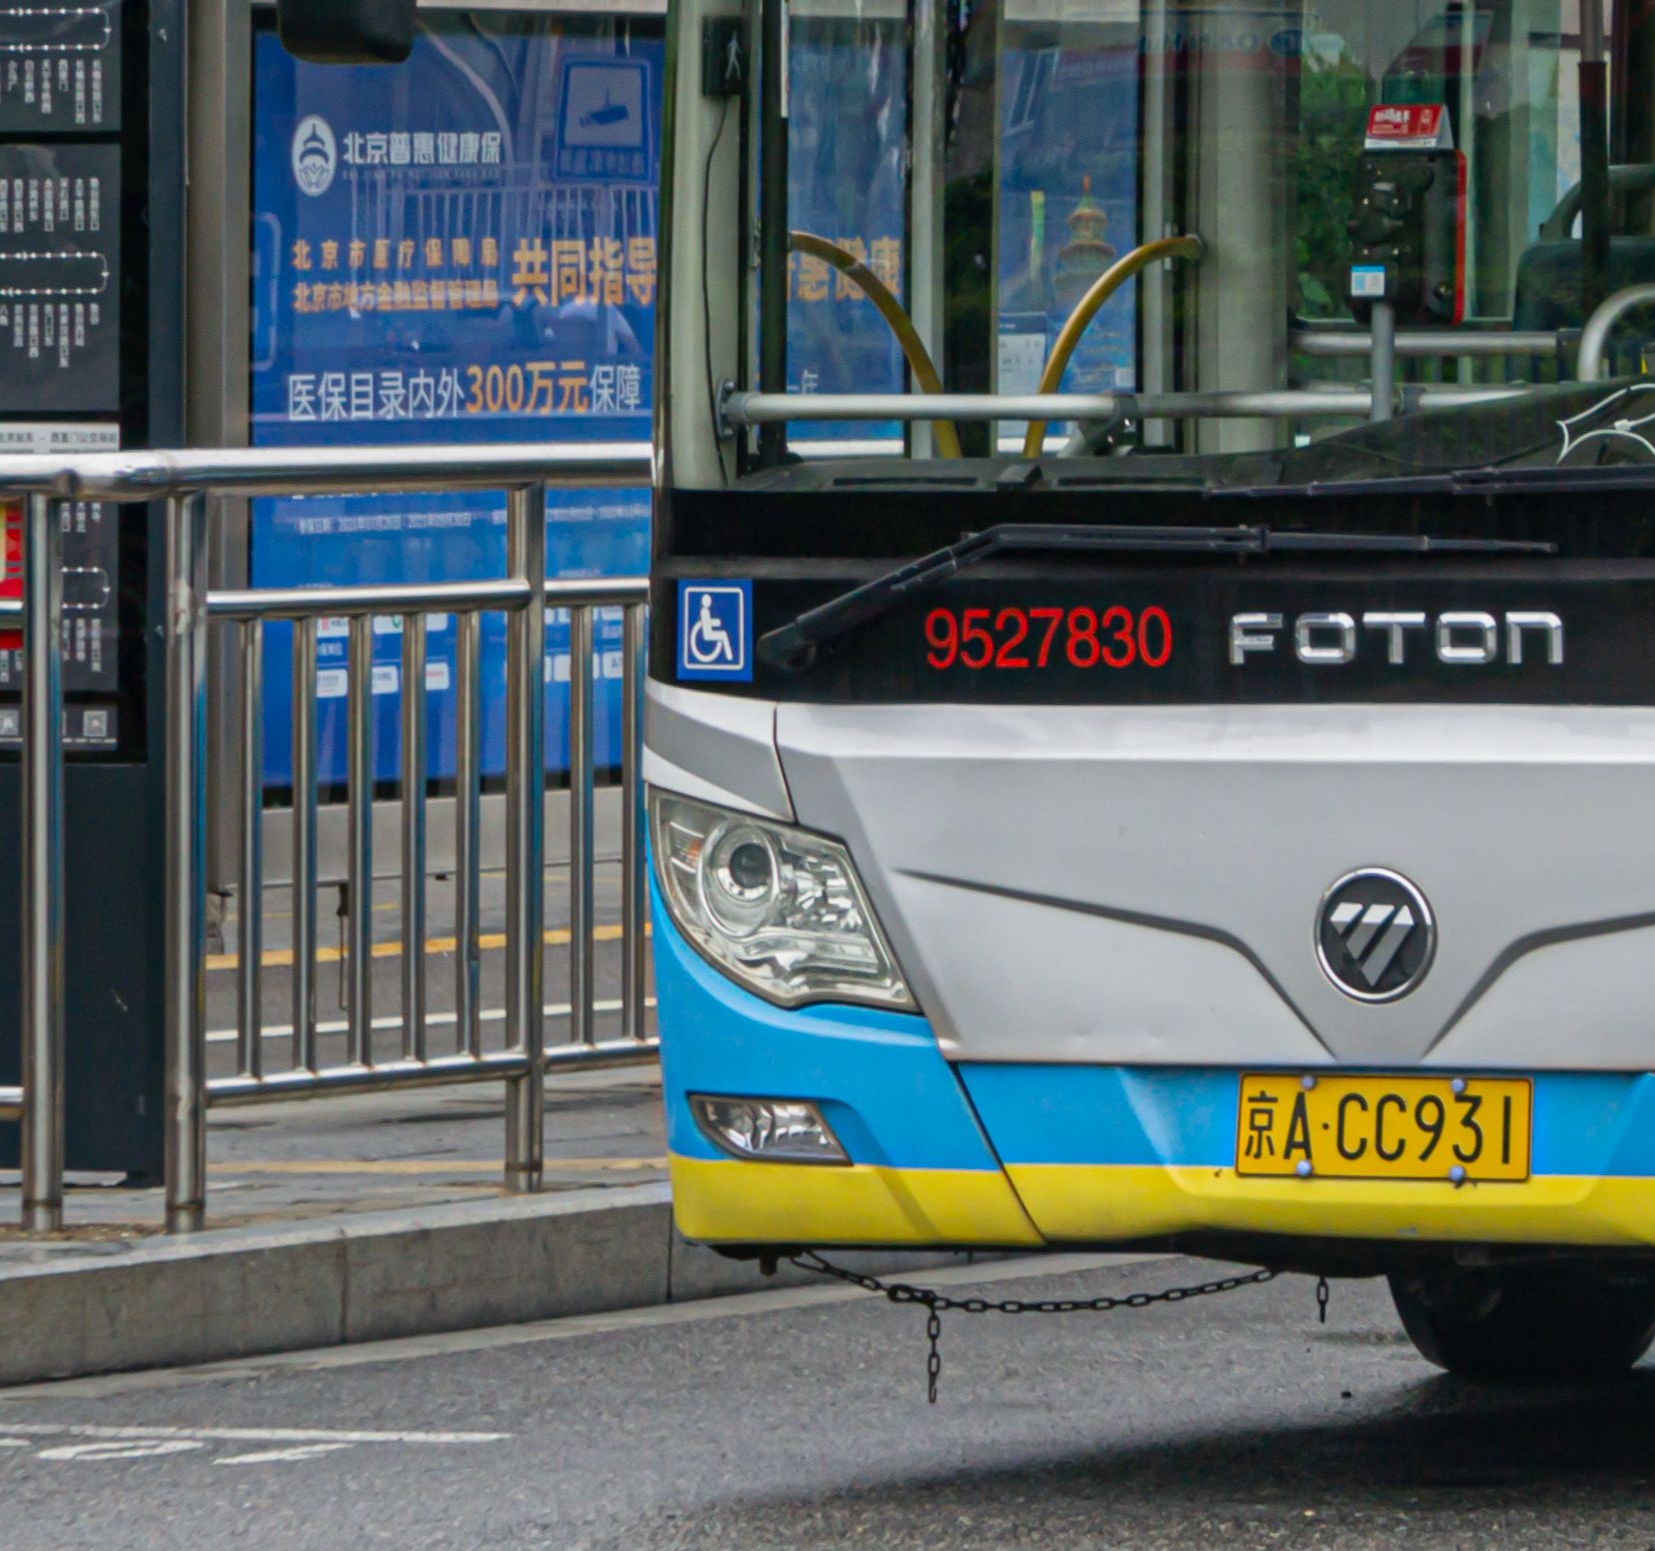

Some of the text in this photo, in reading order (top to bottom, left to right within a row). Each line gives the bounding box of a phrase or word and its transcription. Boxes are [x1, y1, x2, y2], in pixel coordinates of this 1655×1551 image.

[343, 132, 501, 165] 北京普惠健康保
[512, 237, 657, 306] 共同指导
[288, 360, 641, 421] 医保目录内外300万元保障
[925, 605, 1172, 670] 9527830
[1229, 611, 1565, 666] FOTON
